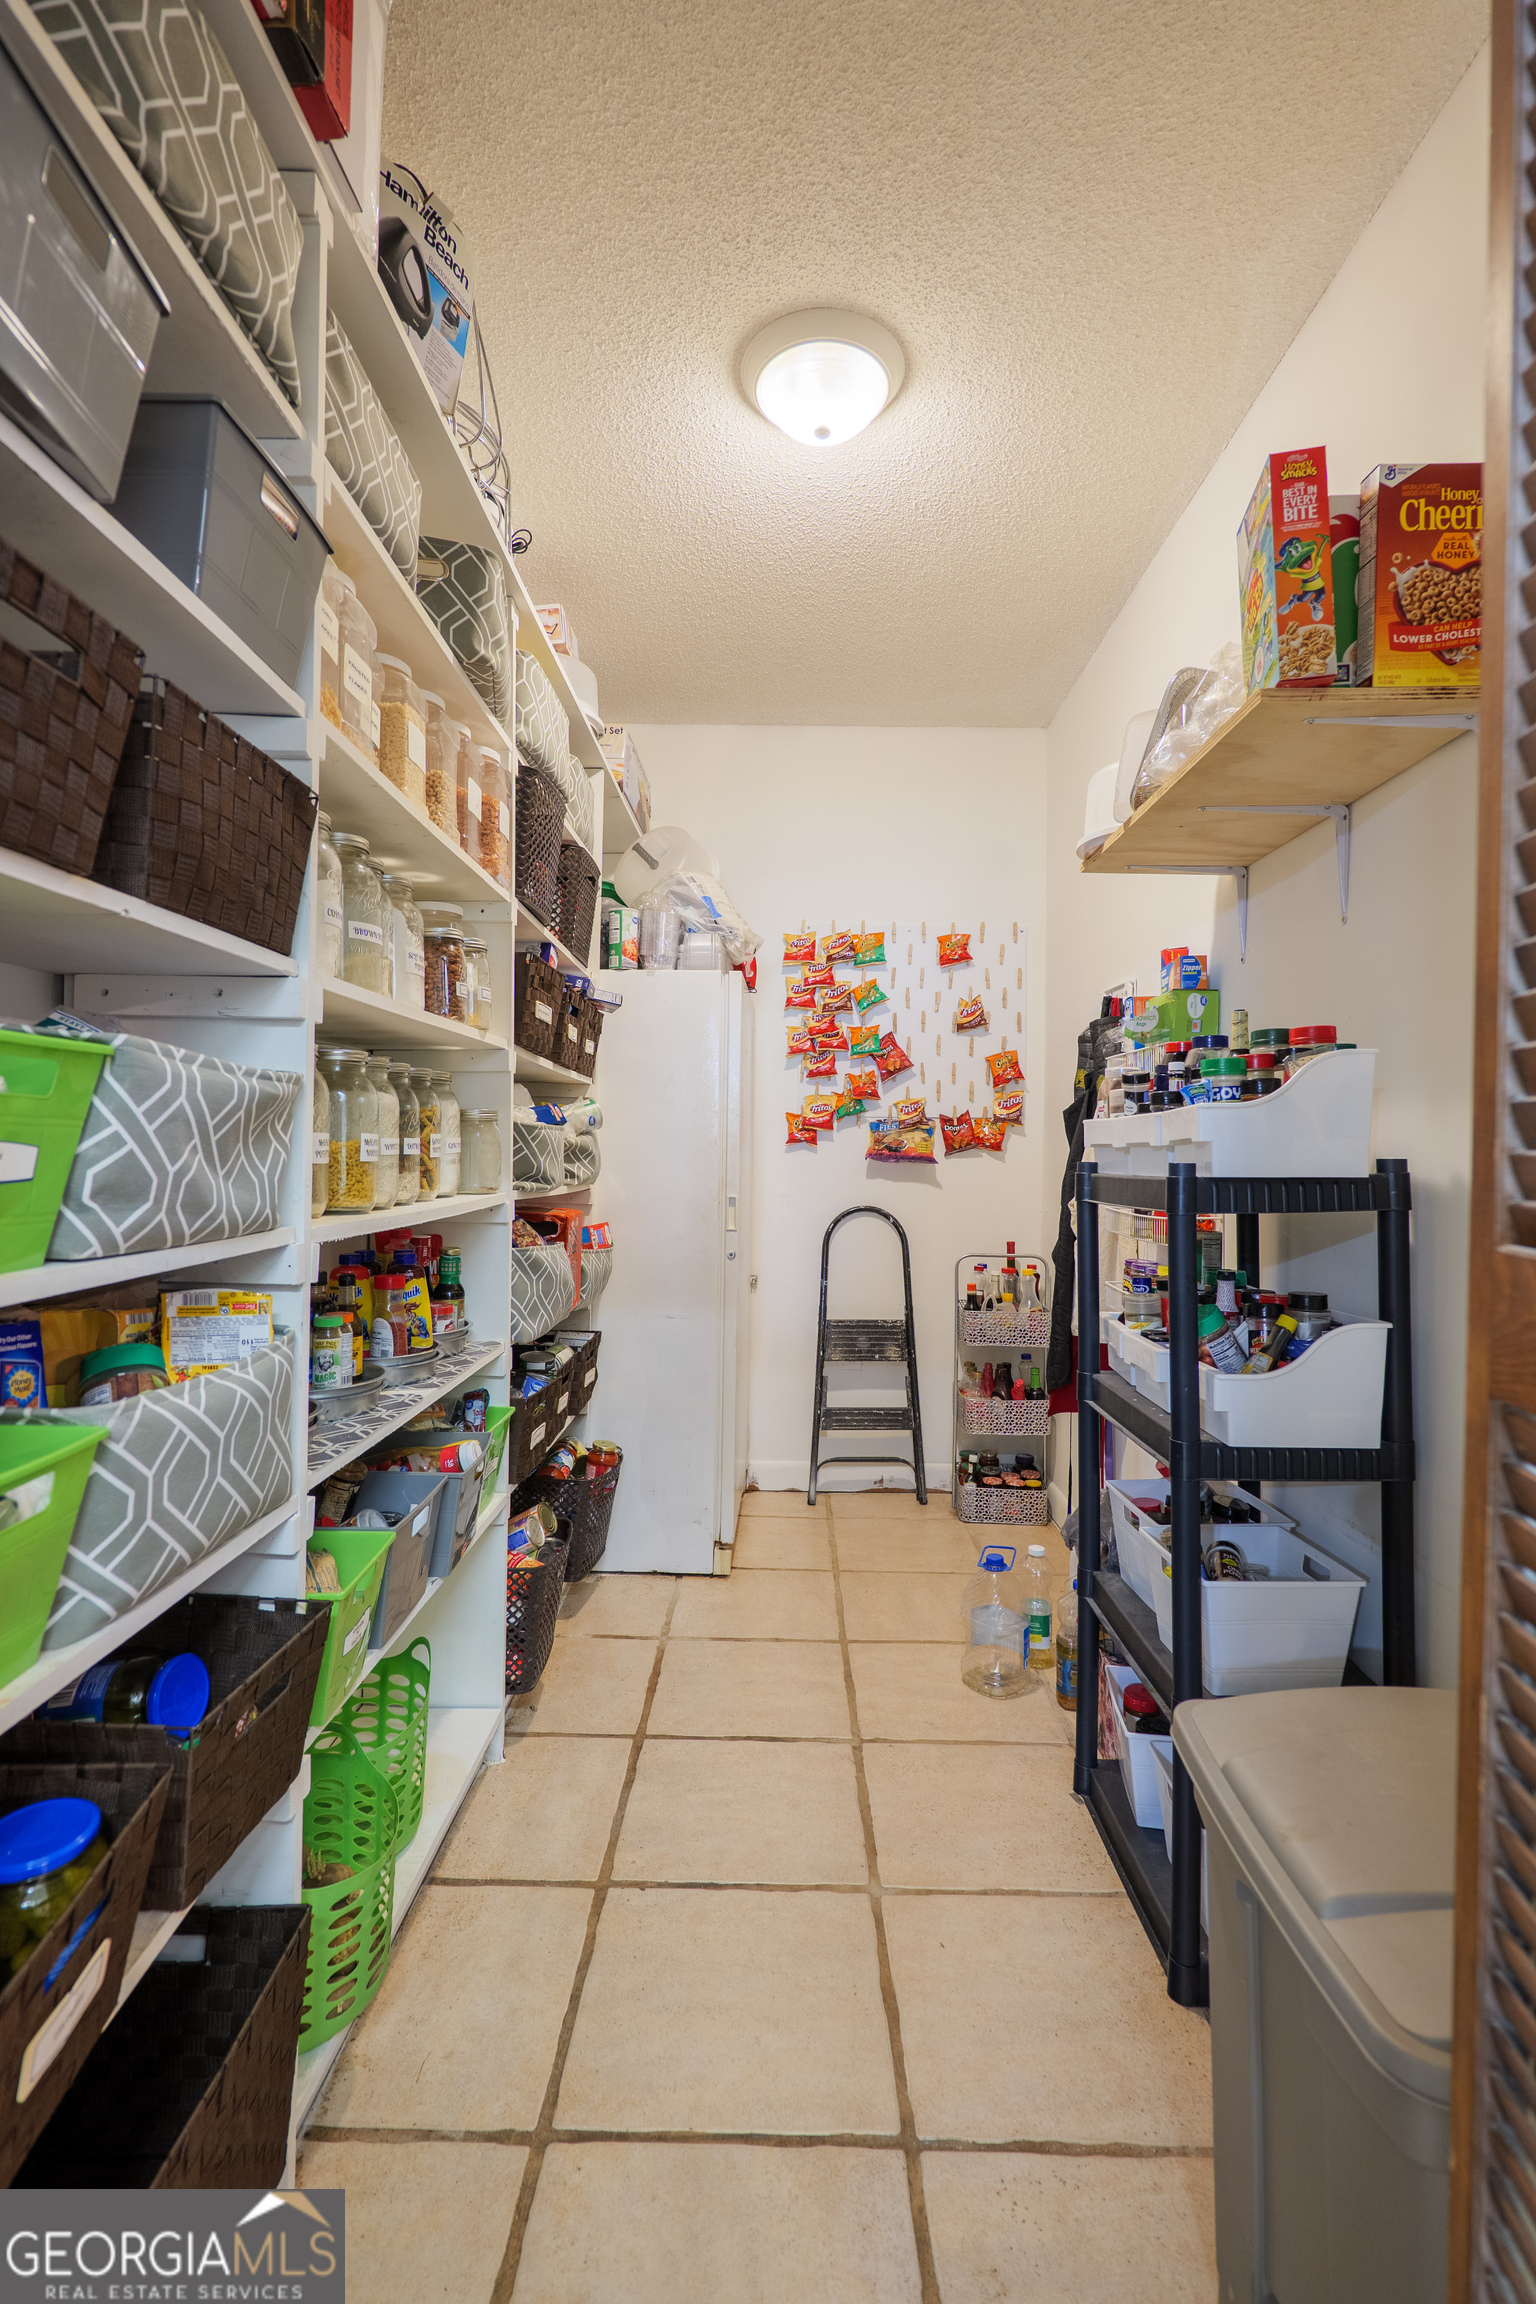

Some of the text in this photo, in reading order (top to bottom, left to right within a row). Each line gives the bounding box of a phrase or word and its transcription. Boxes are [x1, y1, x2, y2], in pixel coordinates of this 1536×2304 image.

[424, 224, 469, 290] Beach
[1281, 467, 1317, 480] SMACKS
[1282, 485, 1317, 498] BEST IN
[1441, 488, 1480, 504] Honey
[1283, 494, 1317, 508] EVERY
[1284, 504, 1318, 522] BITE
[1400, 498, 1483, 531] Cheeri
[1443, 542, 1470, 550] REAL
[1437, 551, 1475, 559] HONEY
[1434, 621, 1473, 633] CAN HELP
[1393, 628, 1482, 644] LOWER CHOLEST
[609, 726, 624, 735] Set
[807, 963, 827, 973] Frito
[1182, 964, 1202, 972] Zipper
[824, 984, 850, 998] Fritos
[58, 1016, 84, 1030] HEAVY
[1213, 1087, 1241, 1101] GOY
[810, 1103, 832, 1113] Fritos
[998, 1096, 1023, 1110] Fritos
[879, 1123, 899, 1132] FIES
[10, 1378, 32, 1387] Honey
[315, 1371, 337, 1384] MAGIC
[14, 1385, 31, 1394] Maid
